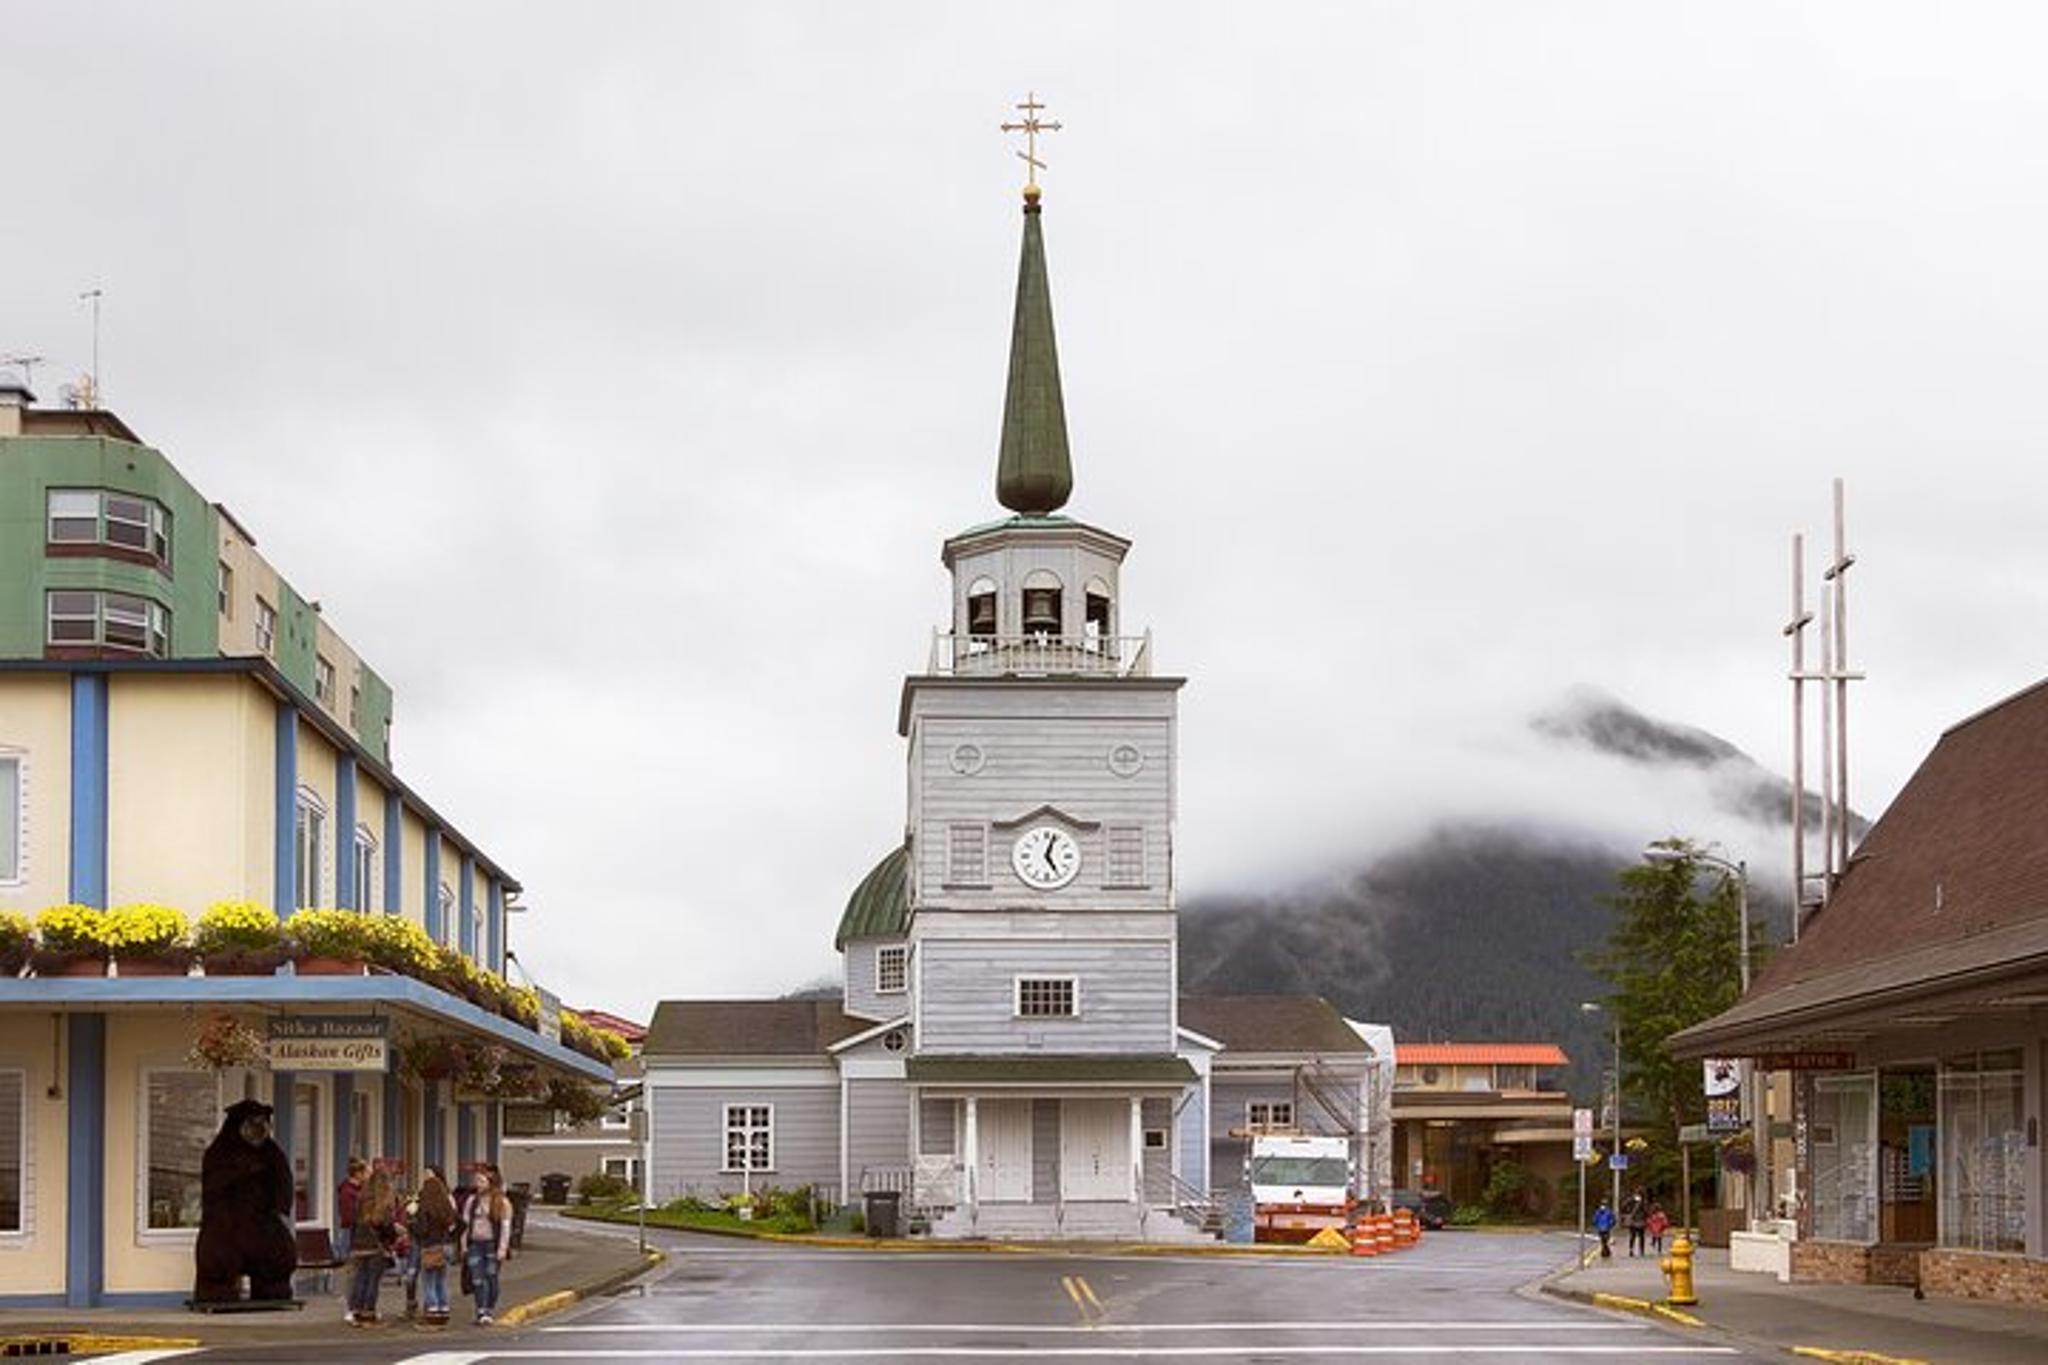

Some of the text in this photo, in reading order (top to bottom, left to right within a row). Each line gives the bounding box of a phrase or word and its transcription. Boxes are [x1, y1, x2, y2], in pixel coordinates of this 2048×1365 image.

[273, 1021, 381, 1035] Sitka Bazaar
[277, 1043, 382, 1063] Alaskan Gifts
